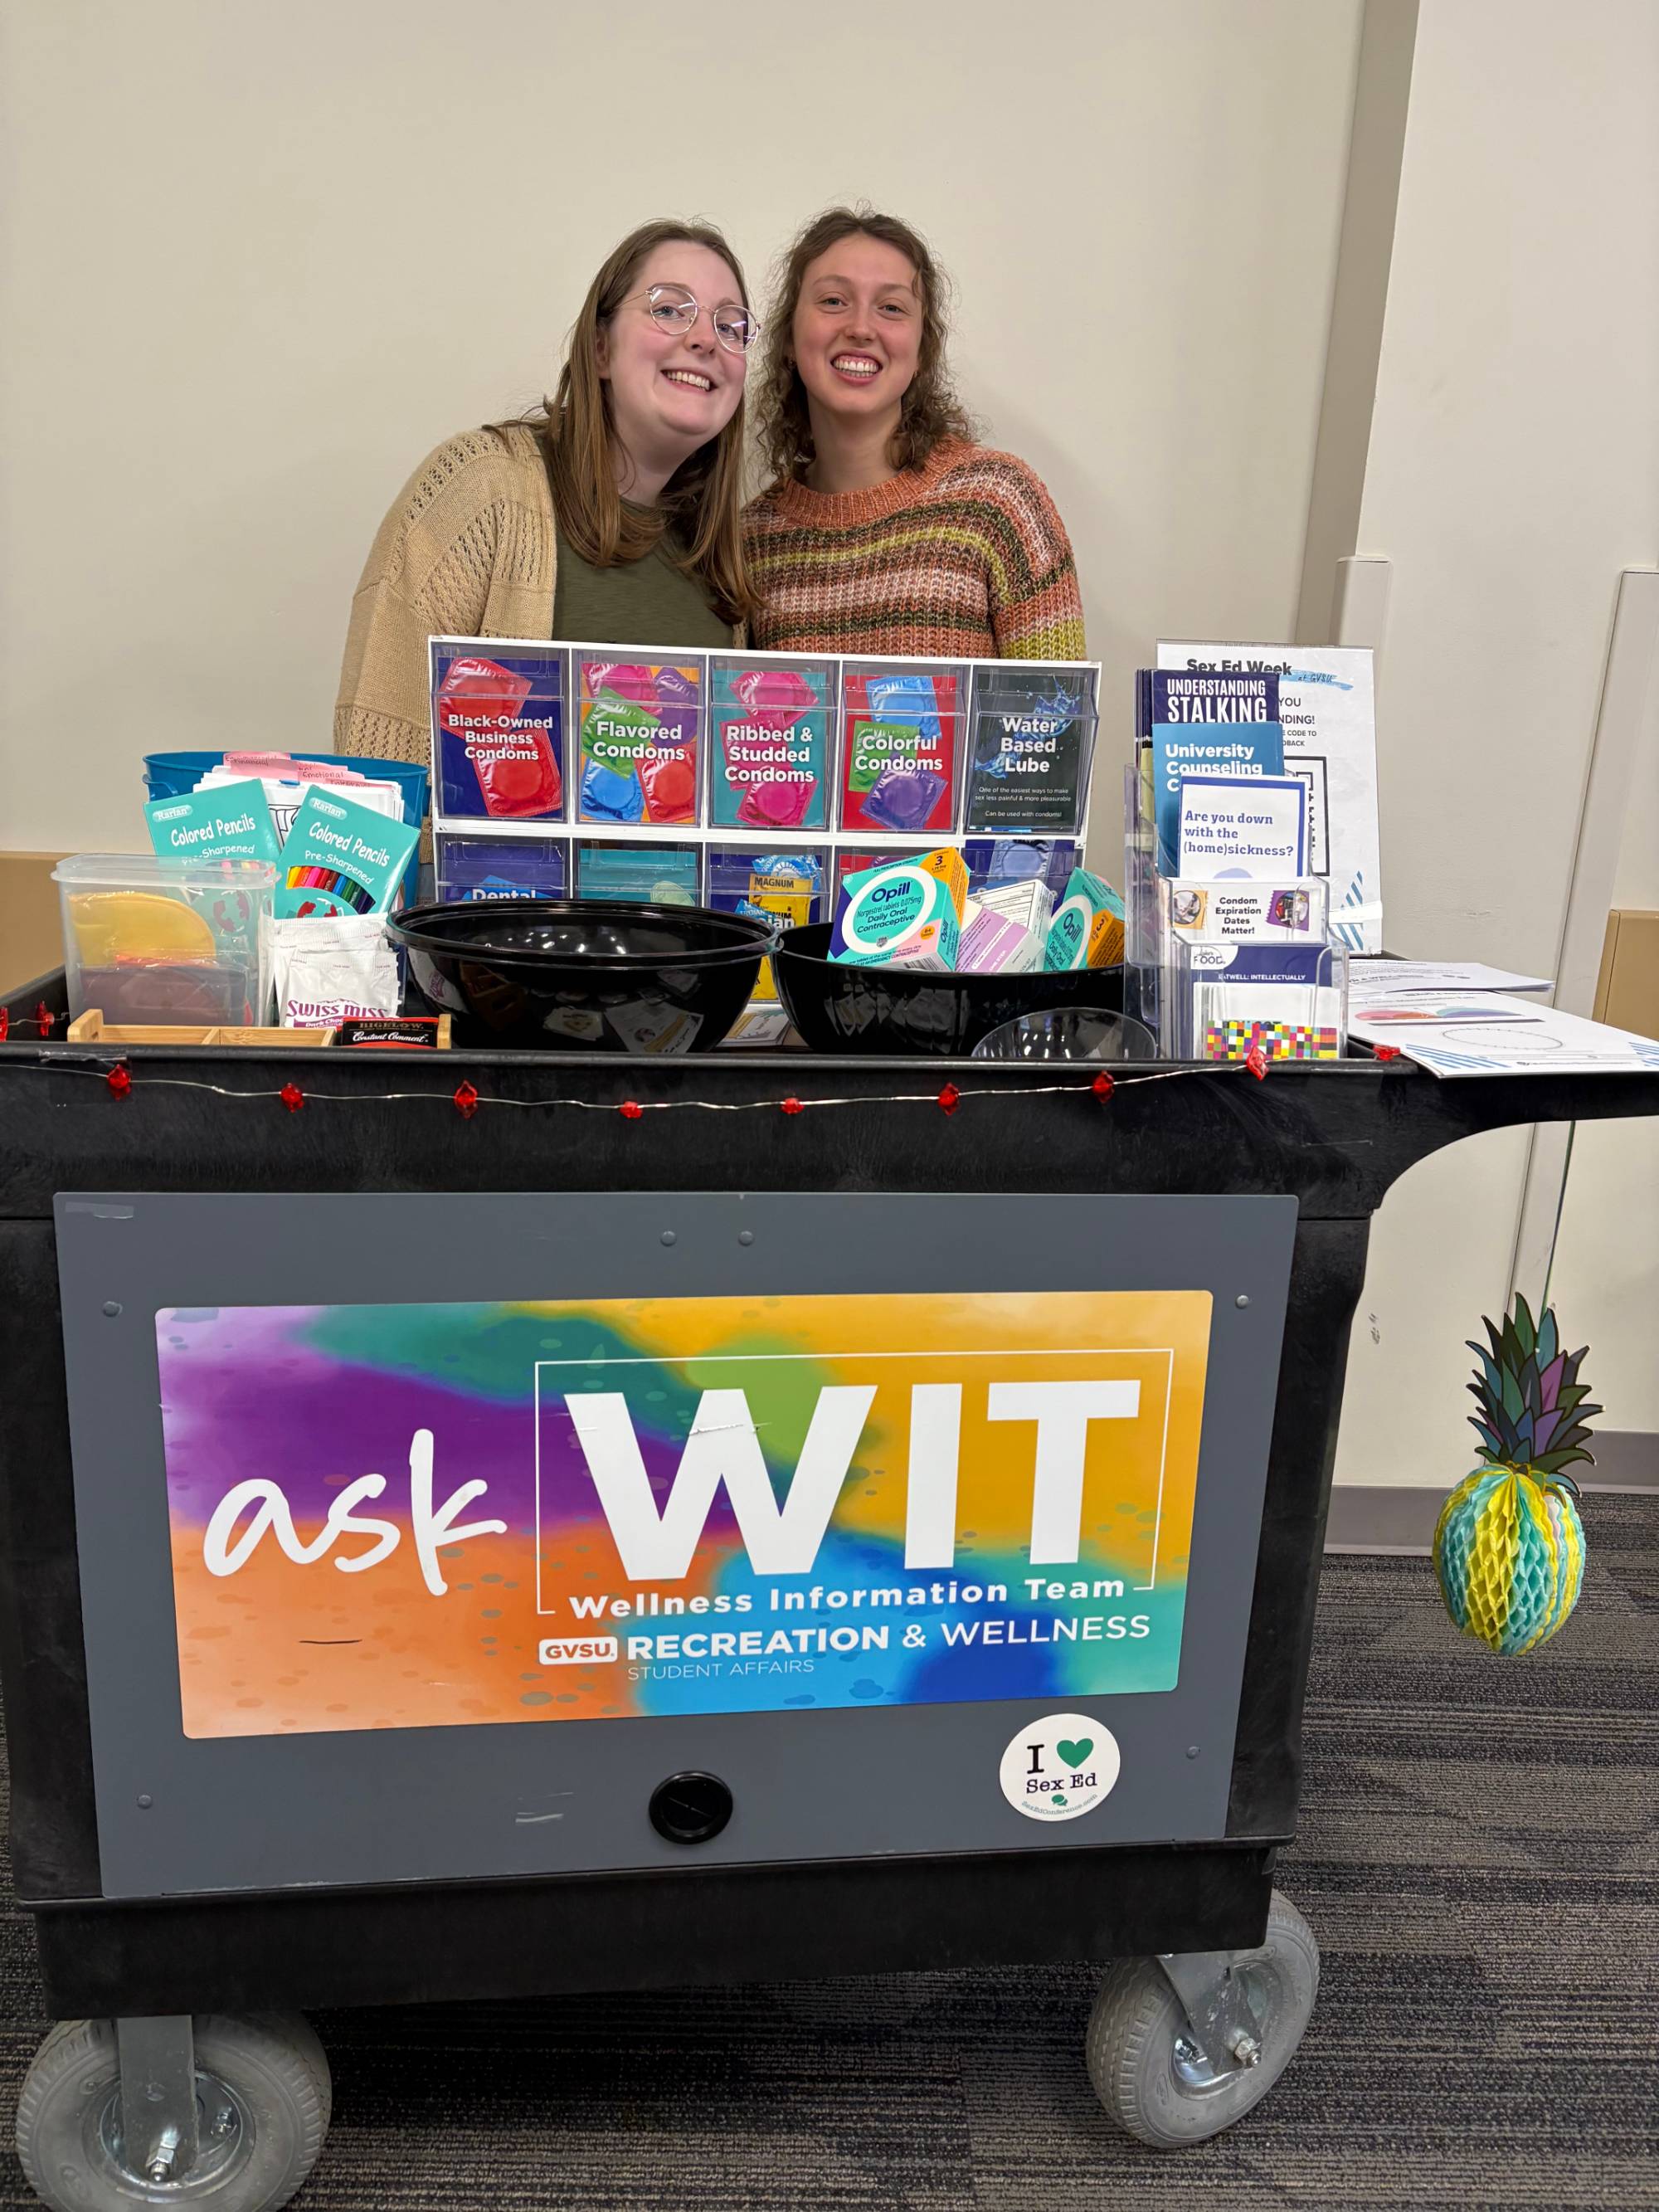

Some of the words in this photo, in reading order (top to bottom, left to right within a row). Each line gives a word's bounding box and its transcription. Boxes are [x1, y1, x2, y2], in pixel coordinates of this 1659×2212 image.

[1187, 659, 1217, 671] Sex
[1222, 660, 1242, 672] Ed
[1247, 660, 1292, 675] Week
[1167, 679, 1266, 695] UNDERSTANDING
[1168, 696, 1267, 723] STALKING
[448, 714, 553, 729] Black-Owned
[1003, 717, 1058, 733] Water
[1278, 715, 1315, 724] NDING!
[465, 731, 533, 745] Business
[596, 721, 683, 740] Flavored
[727, 726, 795, 743] Ribbed
[800, 728, 813, 743] &
[593, 742, 685, 761] Condoms
[862, 735, 937, 751] Colorful
[1000, 738, 1056, 753] Based
[1165, 743, 1254, 760] University
[465, 746, 538, 761] Condoms
[729, 746, 810, 763] Studded
[854, 755, 943, 772] Condoms
[1005, 758, 1050, 773] Lube
[1166, 761, 1262, 775] Counseling
[724, 766, 814, 783] Condoms
[1185, 811, 1209, 822] Are
[1211, 813, 1234, 824] you
[1237, 812, 1273, 825] down
[171, 821, 215, 847] Colored
[216, 813, 256, 836] Pencils
[1185, 826, 1214, 839] with
[1216, 827, 1238, 839] the
[309, 821, 353, 851] Colored
[352, 838, 390, 867] Pencils
[1184, 842, 1294, 857] (home)sickness?
[182, 845, 255, 866] Pre-Sharpened
[935, 855, 943, 865] 3
[304, 850, 375, 884] Pre-Sharpened
[755, 877, 794, 888] MAGNUM
[872, 881, 910, 903] Opill
[1219, 897, 1258, 905] Condom
[868, 913, 888, 923] Daily
[889, 907, 907, 917] Oral
[1215, 907, 1262, 916] Expiration
[857, 914, 916, 933] Contraceptive
[1063, 913, 1082, 943] Opill
[1224, 917, 1250, 925] Dates
[941, 917, 949, 943] Opill
[1221, 927, 1255, 935] Matter!
[203, 1429, 507, 1596] ask
[564, 1380, 1141, 1581] WIT
[569, 1591, 752, 1620] Wellness
[770, 1580, 1008, 1611] Information
[1024, 1578, 1125, 1601] Team
[545, 1642, 611, 1660] GVSU
[628, 1625, 889, 1661] RECREATION
[903, 1625, 927, 1649] &
[940, 1615, 1151, 1647] WELLNESS
[628, 1663, 724, 1680] STUDENT
[729, 1659, 815, 1676] AFFAIRS
[1027, 1744, 1044, 1775] I
[1026, 1778, 1065, 1794] Sex
[1070, 1772, 1097, 1789] Ed
